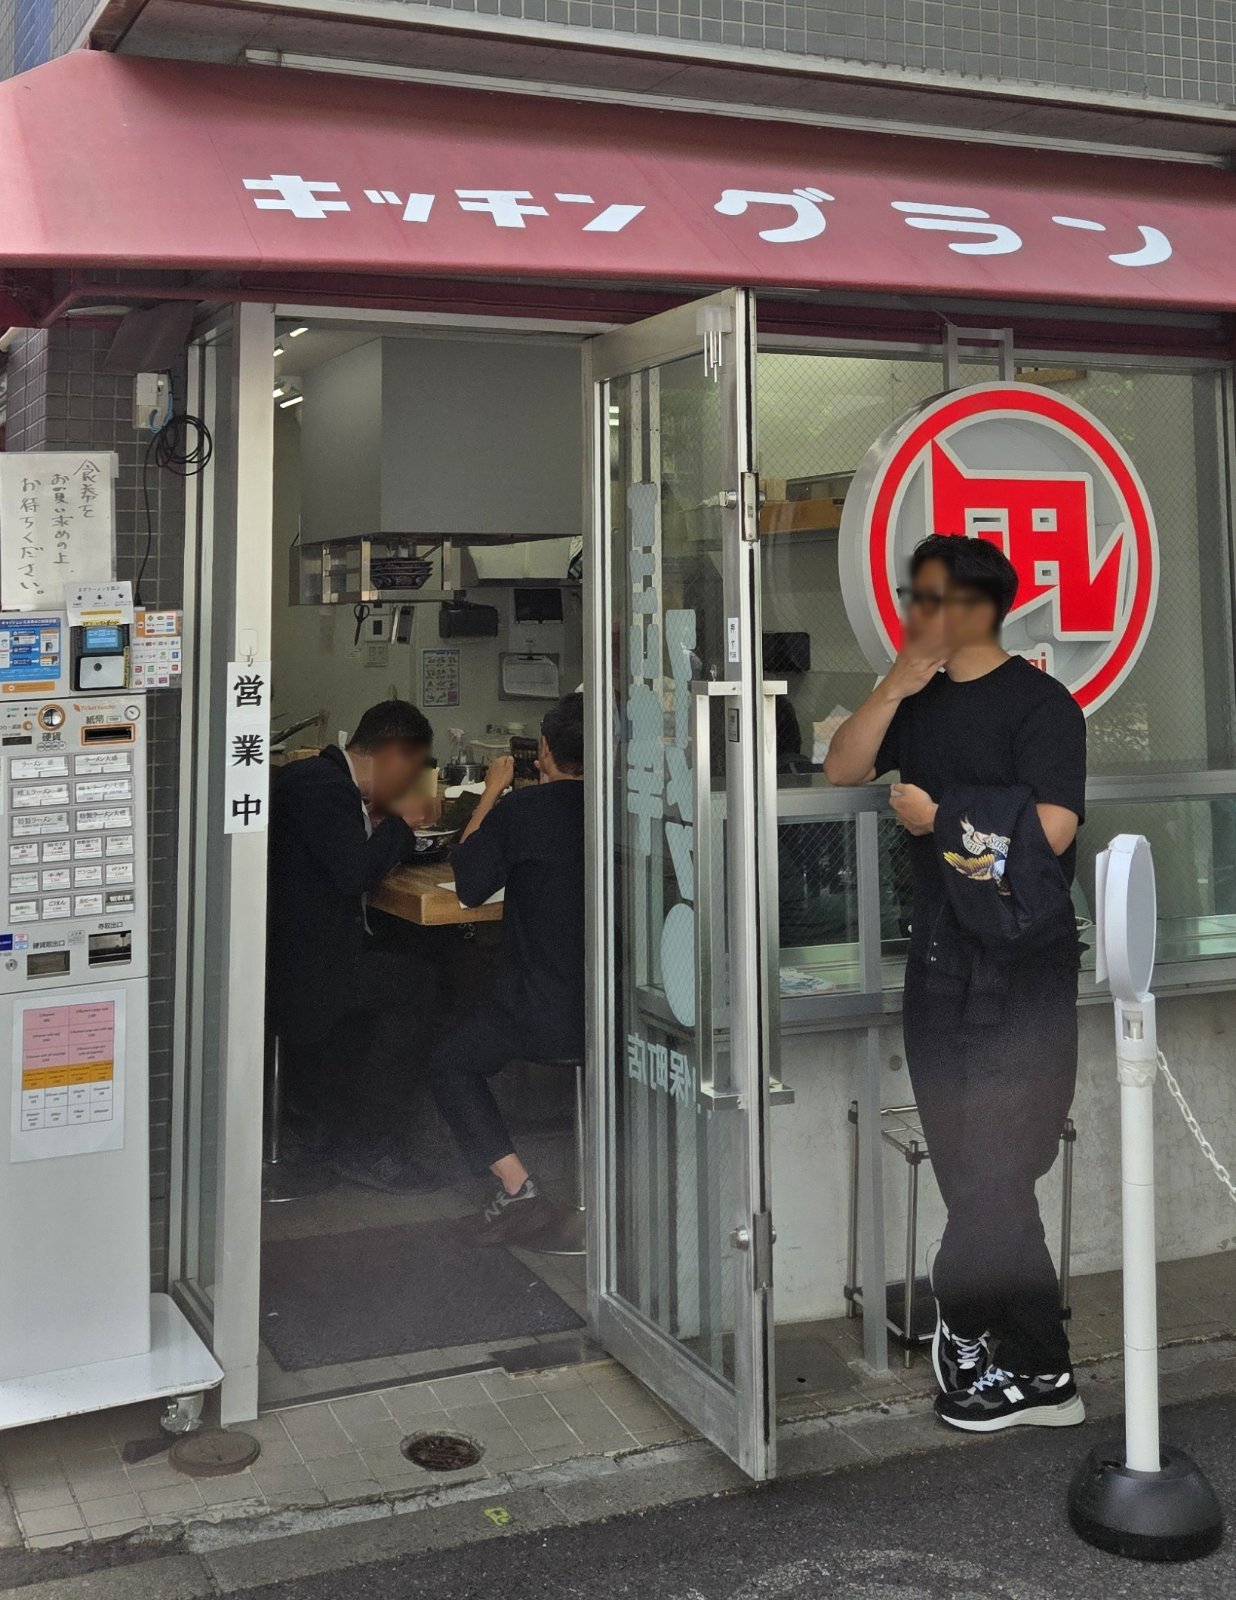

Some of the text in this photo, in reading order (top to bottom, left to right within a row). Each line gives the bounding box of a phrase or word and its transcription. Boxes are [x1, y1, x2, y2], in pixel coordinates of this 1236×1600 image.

[51, 473, 74, 565] お買い求めの上
[73, 458, 100, 518] 食券を
[232, 674, 264, 827] 営業中
